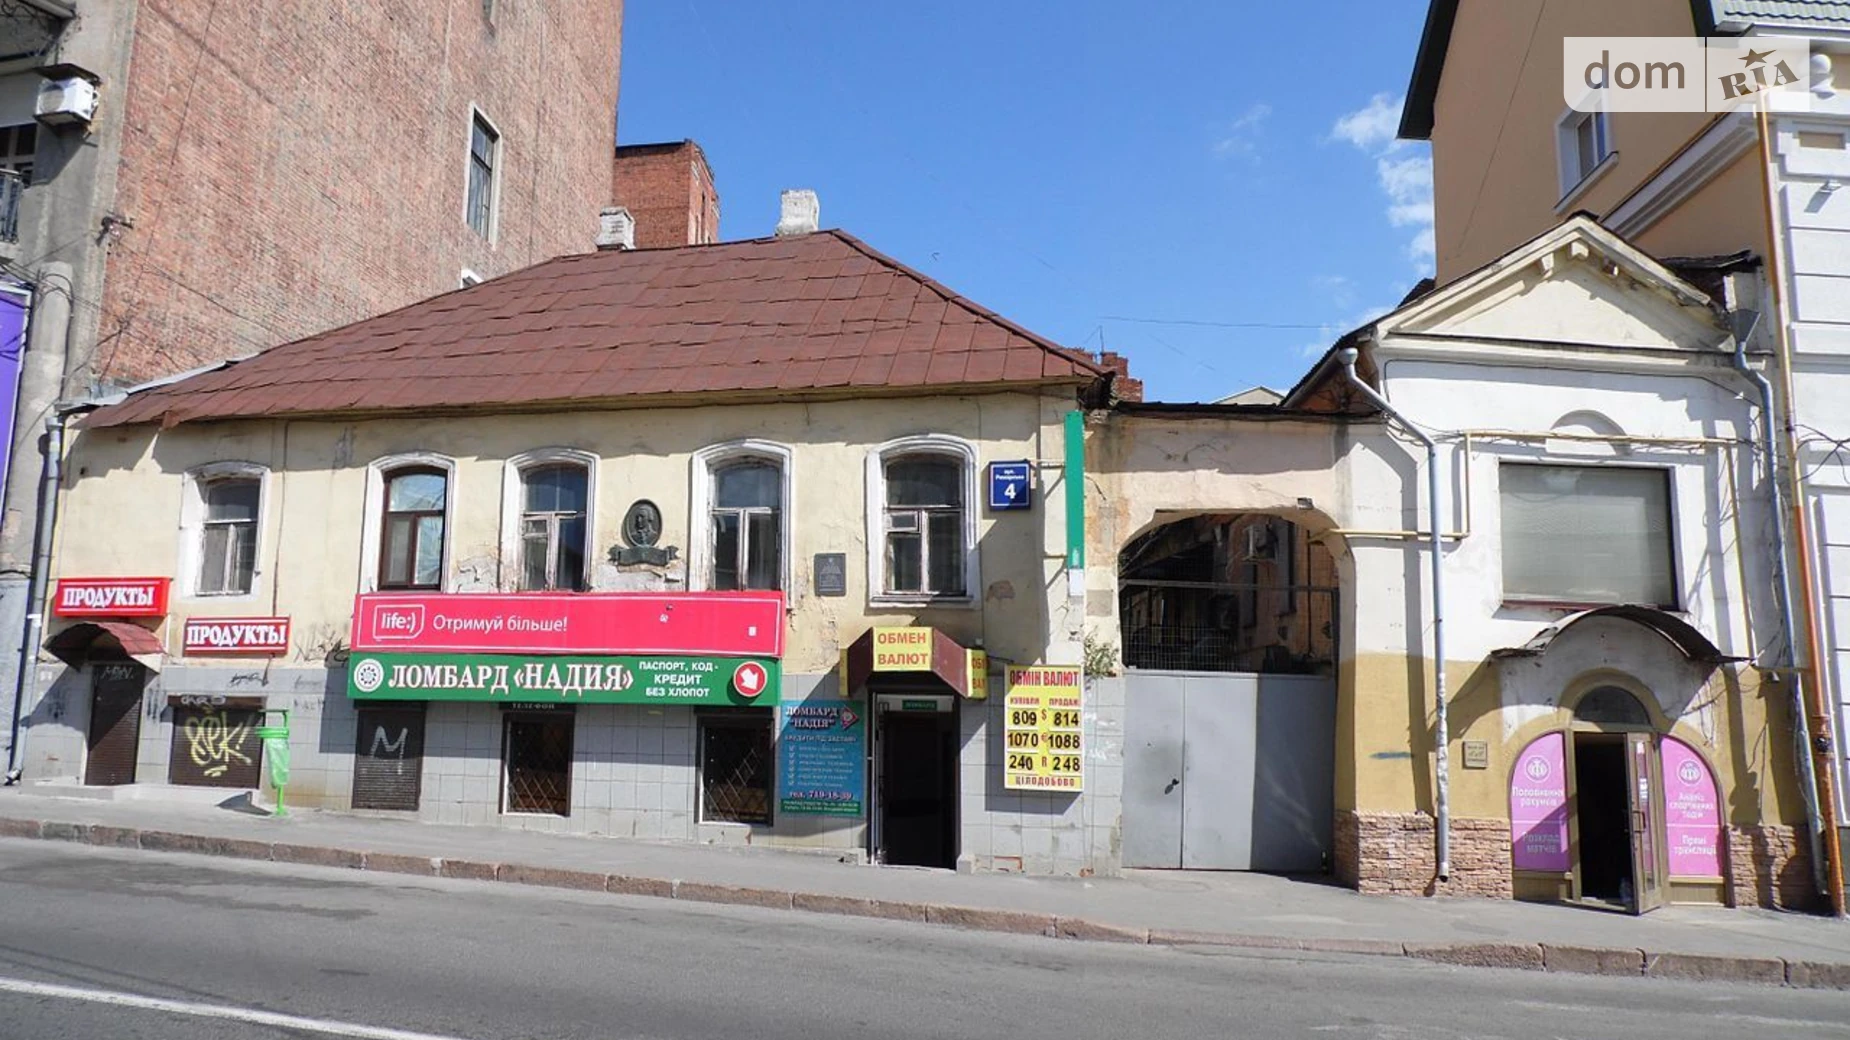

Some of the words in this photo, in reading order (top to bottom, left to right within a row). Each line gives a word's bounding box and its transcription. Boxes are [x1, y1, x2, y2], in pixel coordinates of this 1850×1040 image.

[1004, 483, 1016, 499] 4
[62, 587, 154, 609] ПРОДУКТЫ
[381, 613, 416, 633] life:)
[433, 614, 503, 634] Отримуй
[507, 616, 568, 632] більше!
[186, 624, 287, 647] ПРОДУКТЫ
[878, 632, 926, 644] ОБМЕН
[639, 661, 689, 672] ПАСПОРТ,
[878, 653, 928, 665] ВАЛЮТ
[388, 665, 509, 695] ЛОМБАРД
[513, 663, 634, 697] «НАДИЯ»
[654, 674, 702, 686] КРЕДИТ
[1009, 670, 1041, 686] ОБМІН
[1043, 671, 1078, 687] ВАЛЮТ
[646, 687, 665, 697] БЕЗ
[668, 688, 710, 697] ХЛОПОТ
[785, 707, 838, 717] ЛОМБАРД
[1012, 710, 1037, 726] 809
[1041, 709, 1047, 721] $
[1054, 712, 1079, 726] 814
[1008, 732, 1039, 747] 1070
[1048, 734, 1080, 749] 1088
[1009, 755, 1033, 771] 240
[1053, 756, 1080, 772] 248
[1015, 777, 1075, 787] ЦІЛОДОБОВО
